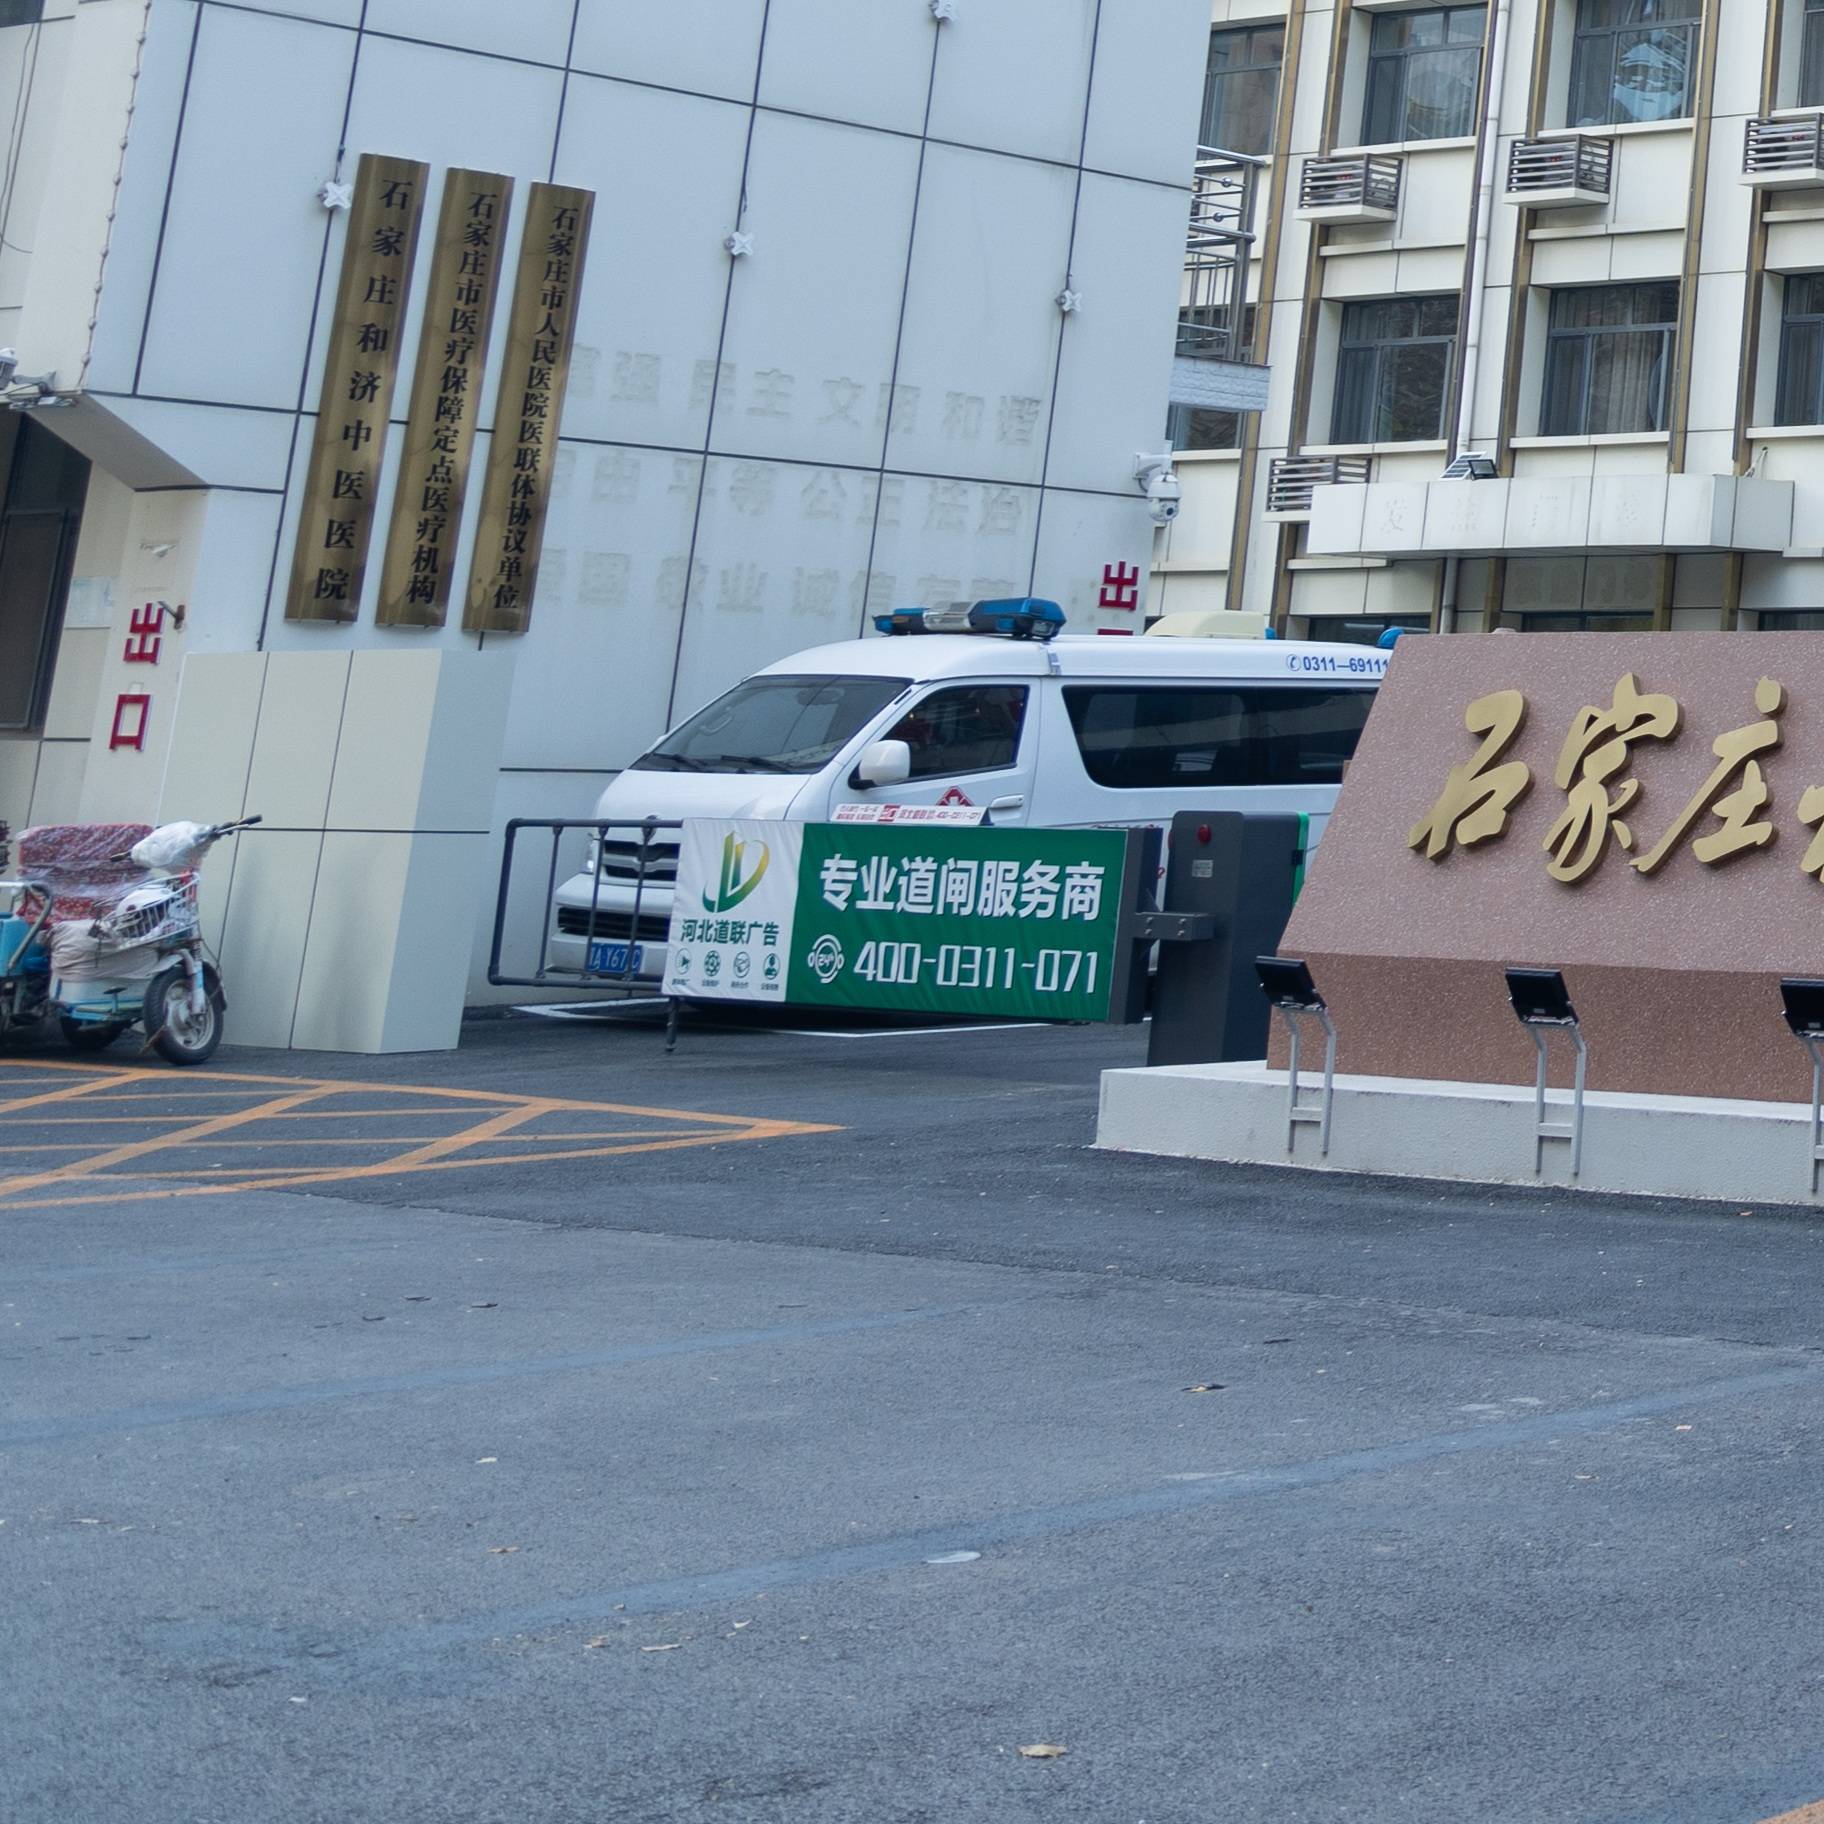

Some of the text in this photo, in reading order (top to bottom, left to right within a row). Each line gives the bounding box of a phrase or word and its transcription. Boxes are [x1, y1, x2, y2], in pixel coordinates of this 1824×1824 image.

[313, 178, 414, 603] 石家庄和济中医医院
[406, 191, 498, 606] 石家庄市医疗保障定点医疗机构
[493, 206, 579, 610] 石家庄市人民医院医联体协议单位
[109, 602, 165, 753] 出口
[680, 918, 780, 947] 河北道联广告
[819, 853, 1105, 922] 专业道闸服务商
[853, 940, 1098, 994] 400-0311-071
